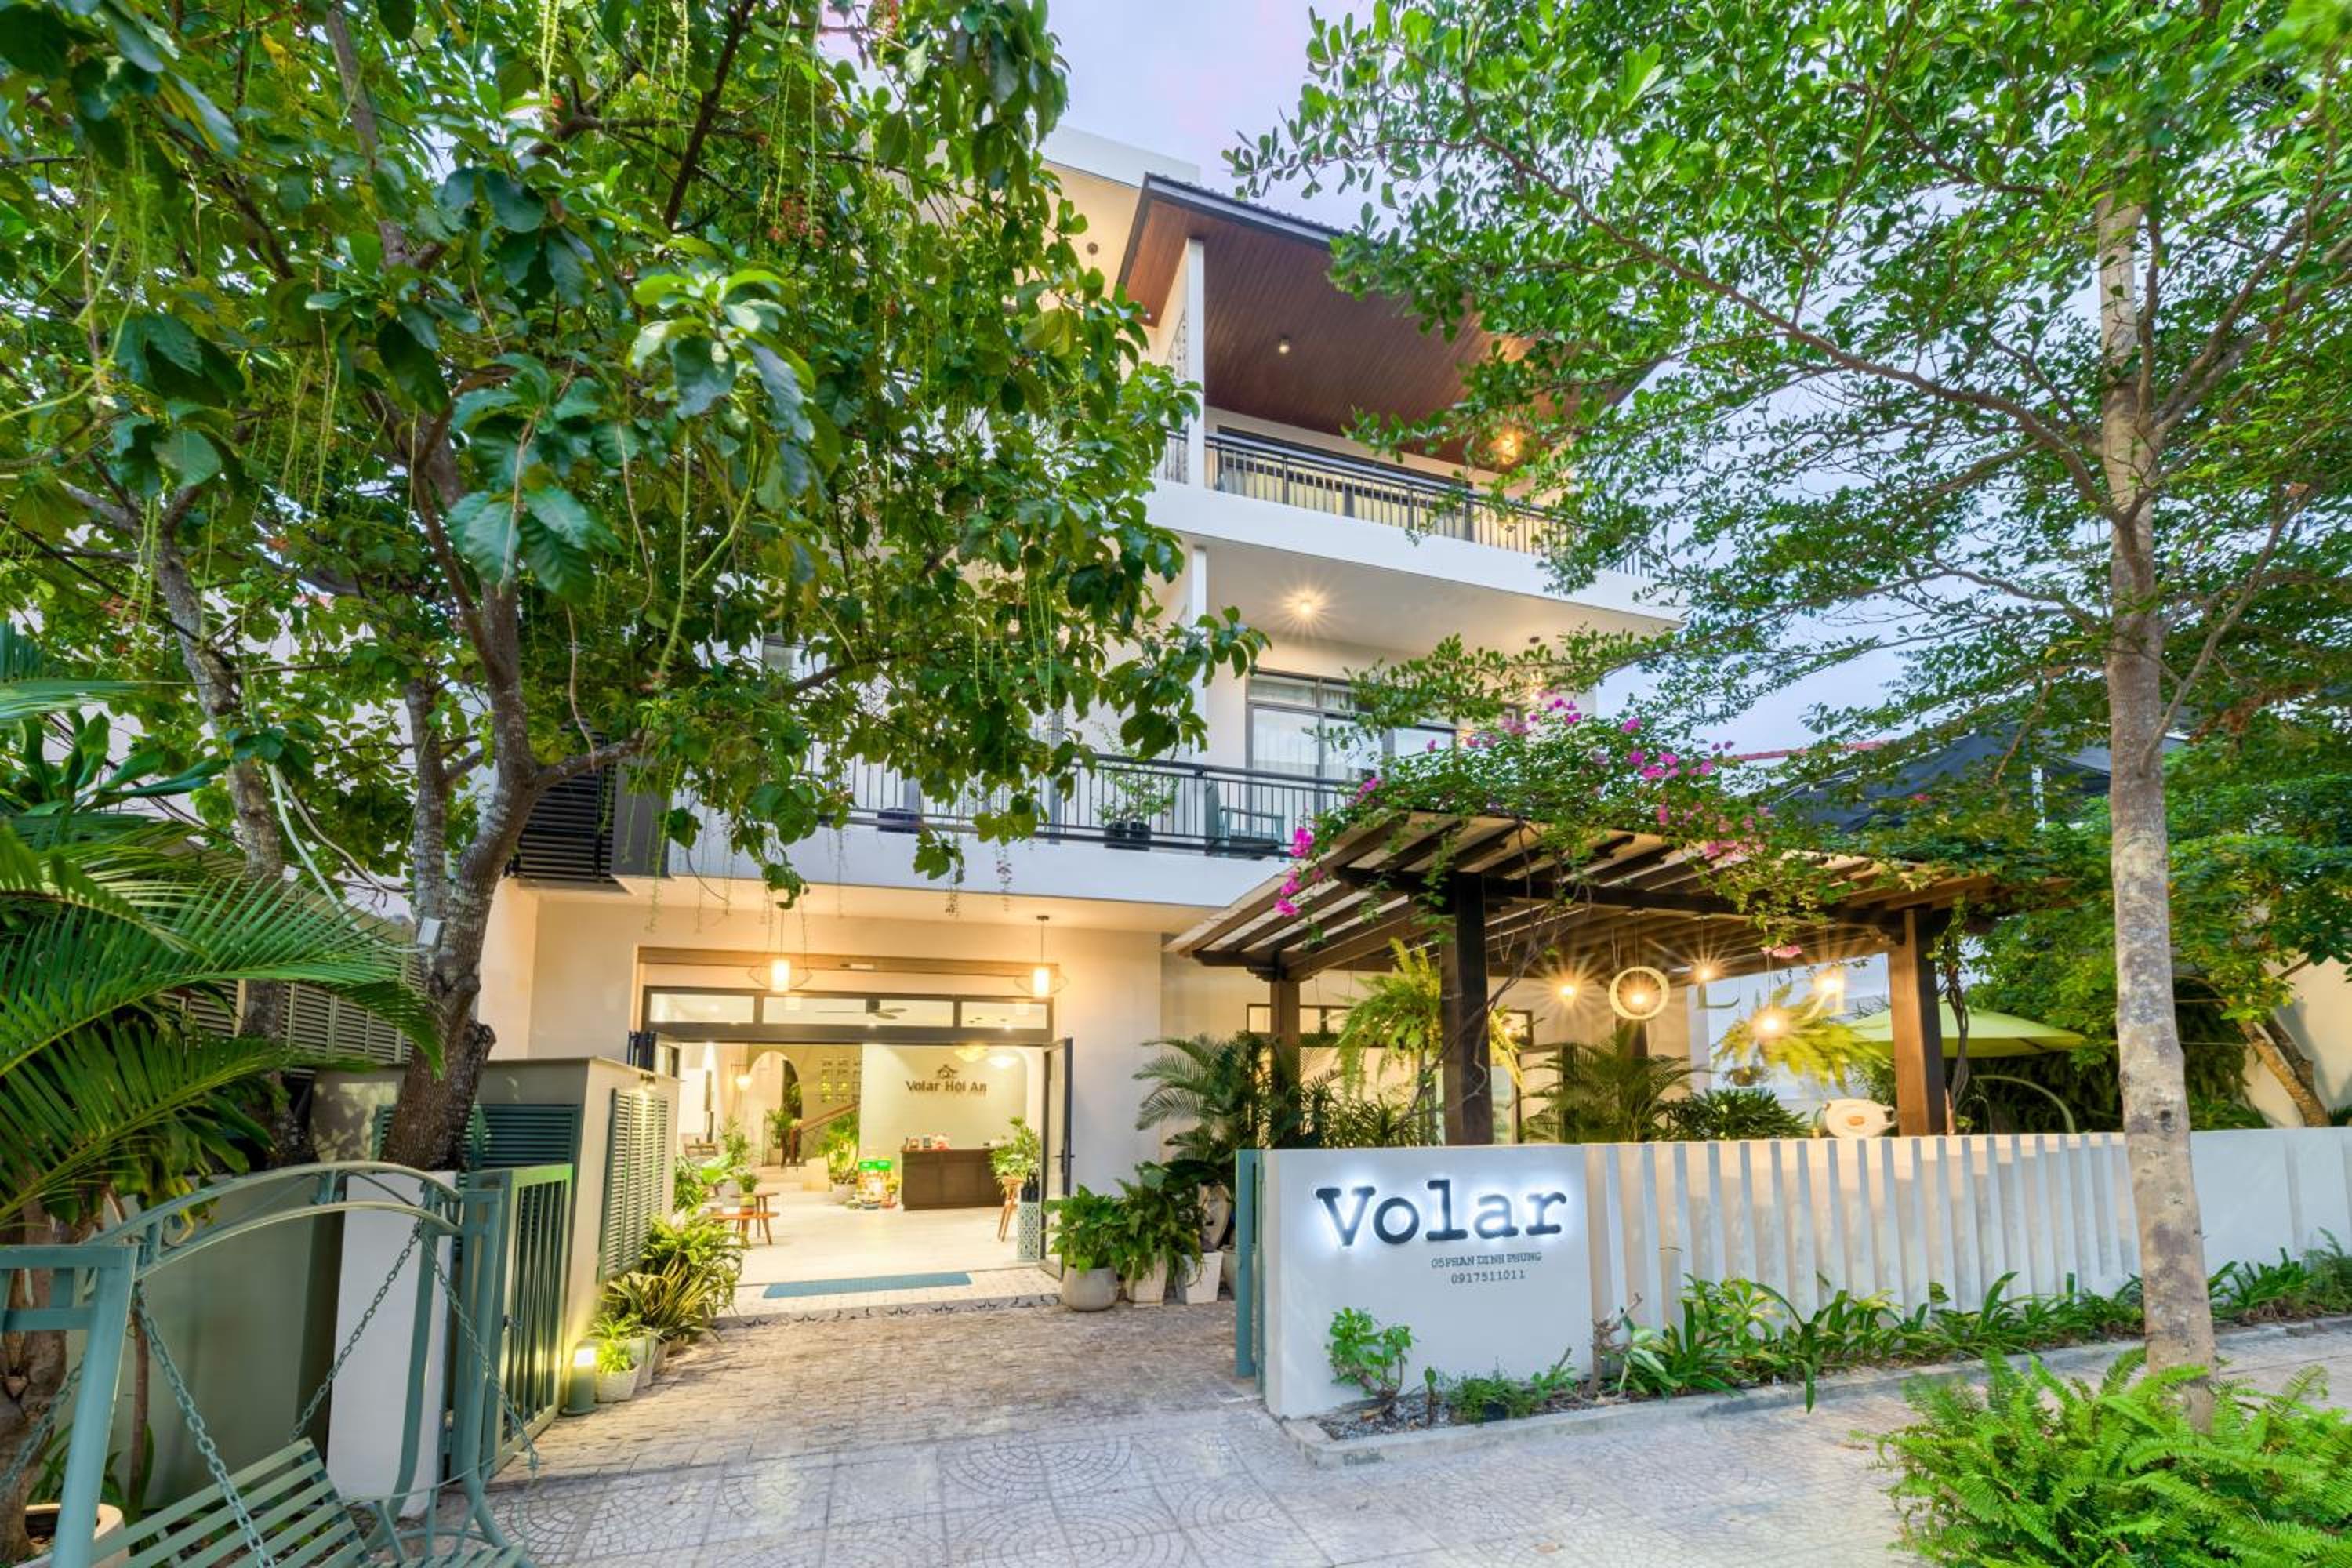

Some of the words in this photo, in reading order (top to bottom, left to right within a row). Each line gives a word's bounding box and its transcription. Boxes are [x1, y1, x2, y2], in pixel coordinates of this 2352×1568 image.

[905, 1080, 942, 1092] Volar
[970, 1081, 988, 1092] An
[1315, 1178, 1567, 1247] Volar
[1450, 1269, 1526, 1284] 0917511011
